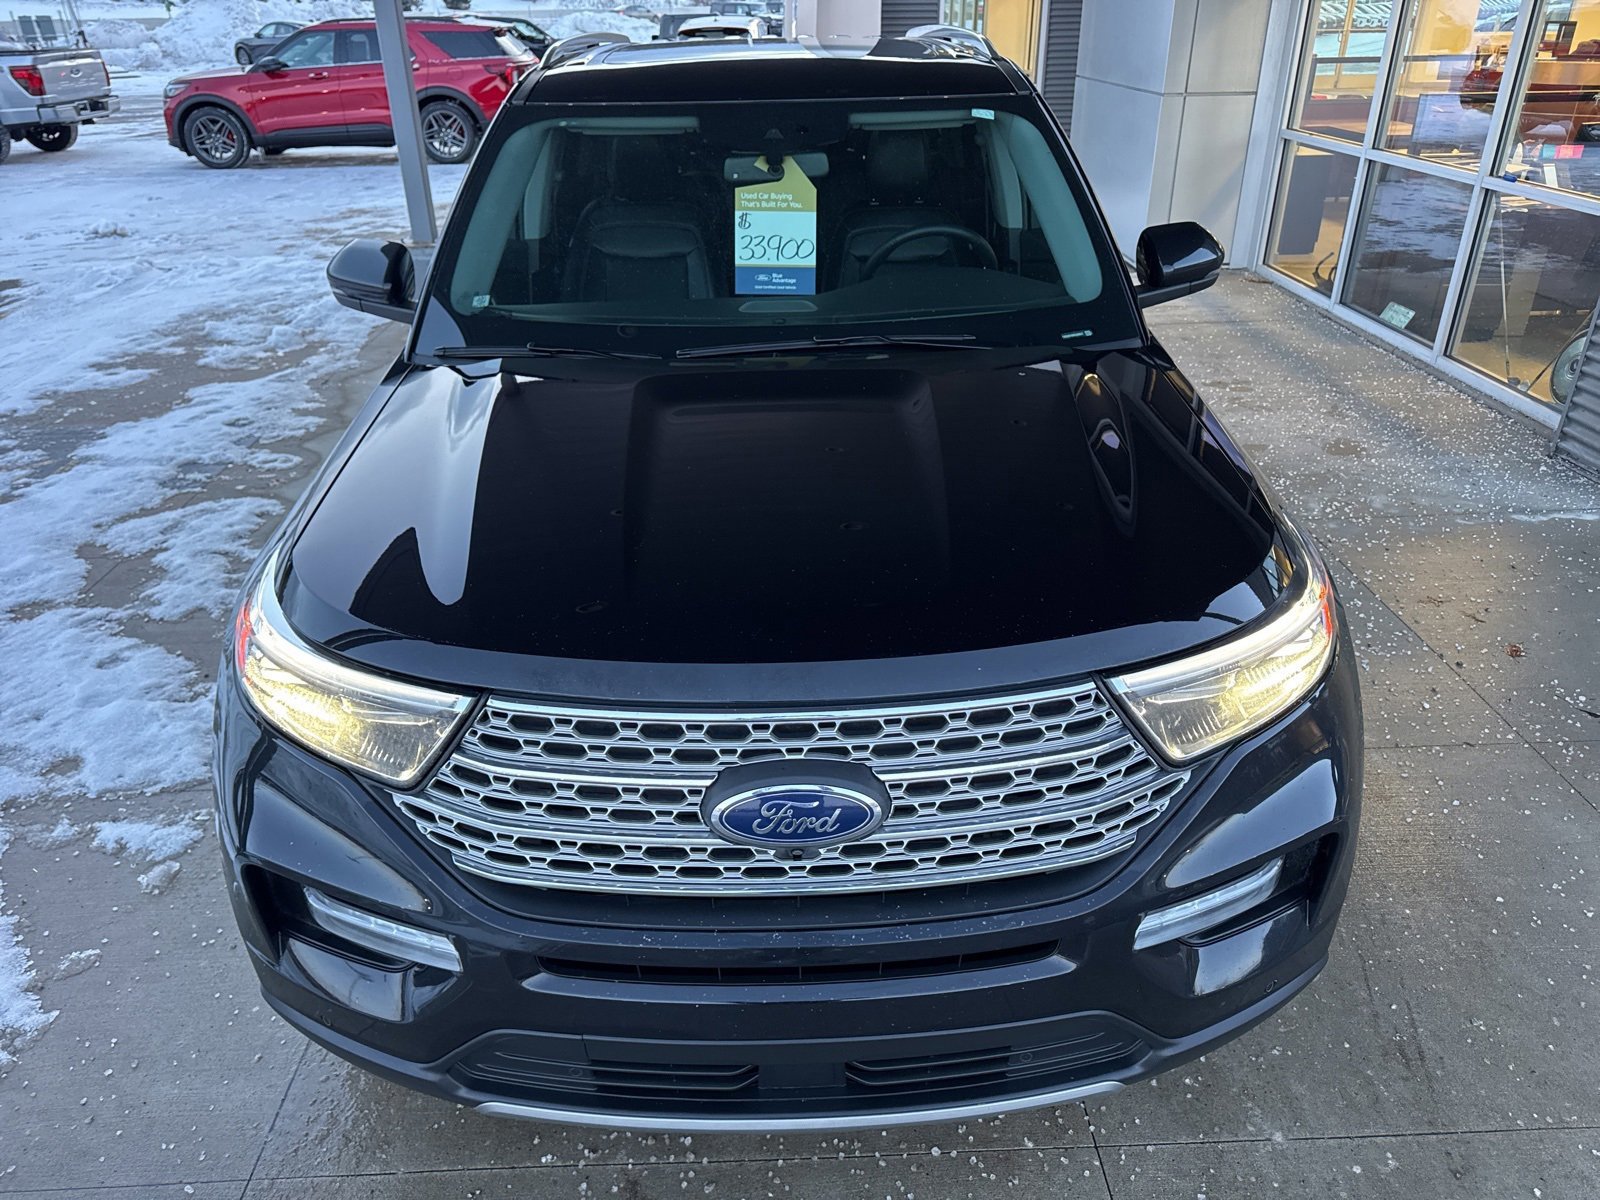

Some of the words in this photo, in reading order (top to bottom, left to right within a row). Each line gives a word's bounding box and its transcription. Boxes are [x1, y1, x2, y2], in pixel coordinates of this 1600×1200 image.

[771, 192, 792, 200] Buying
[738, 212, 752, 229] $
[752, 800, 842, 834] Ford
